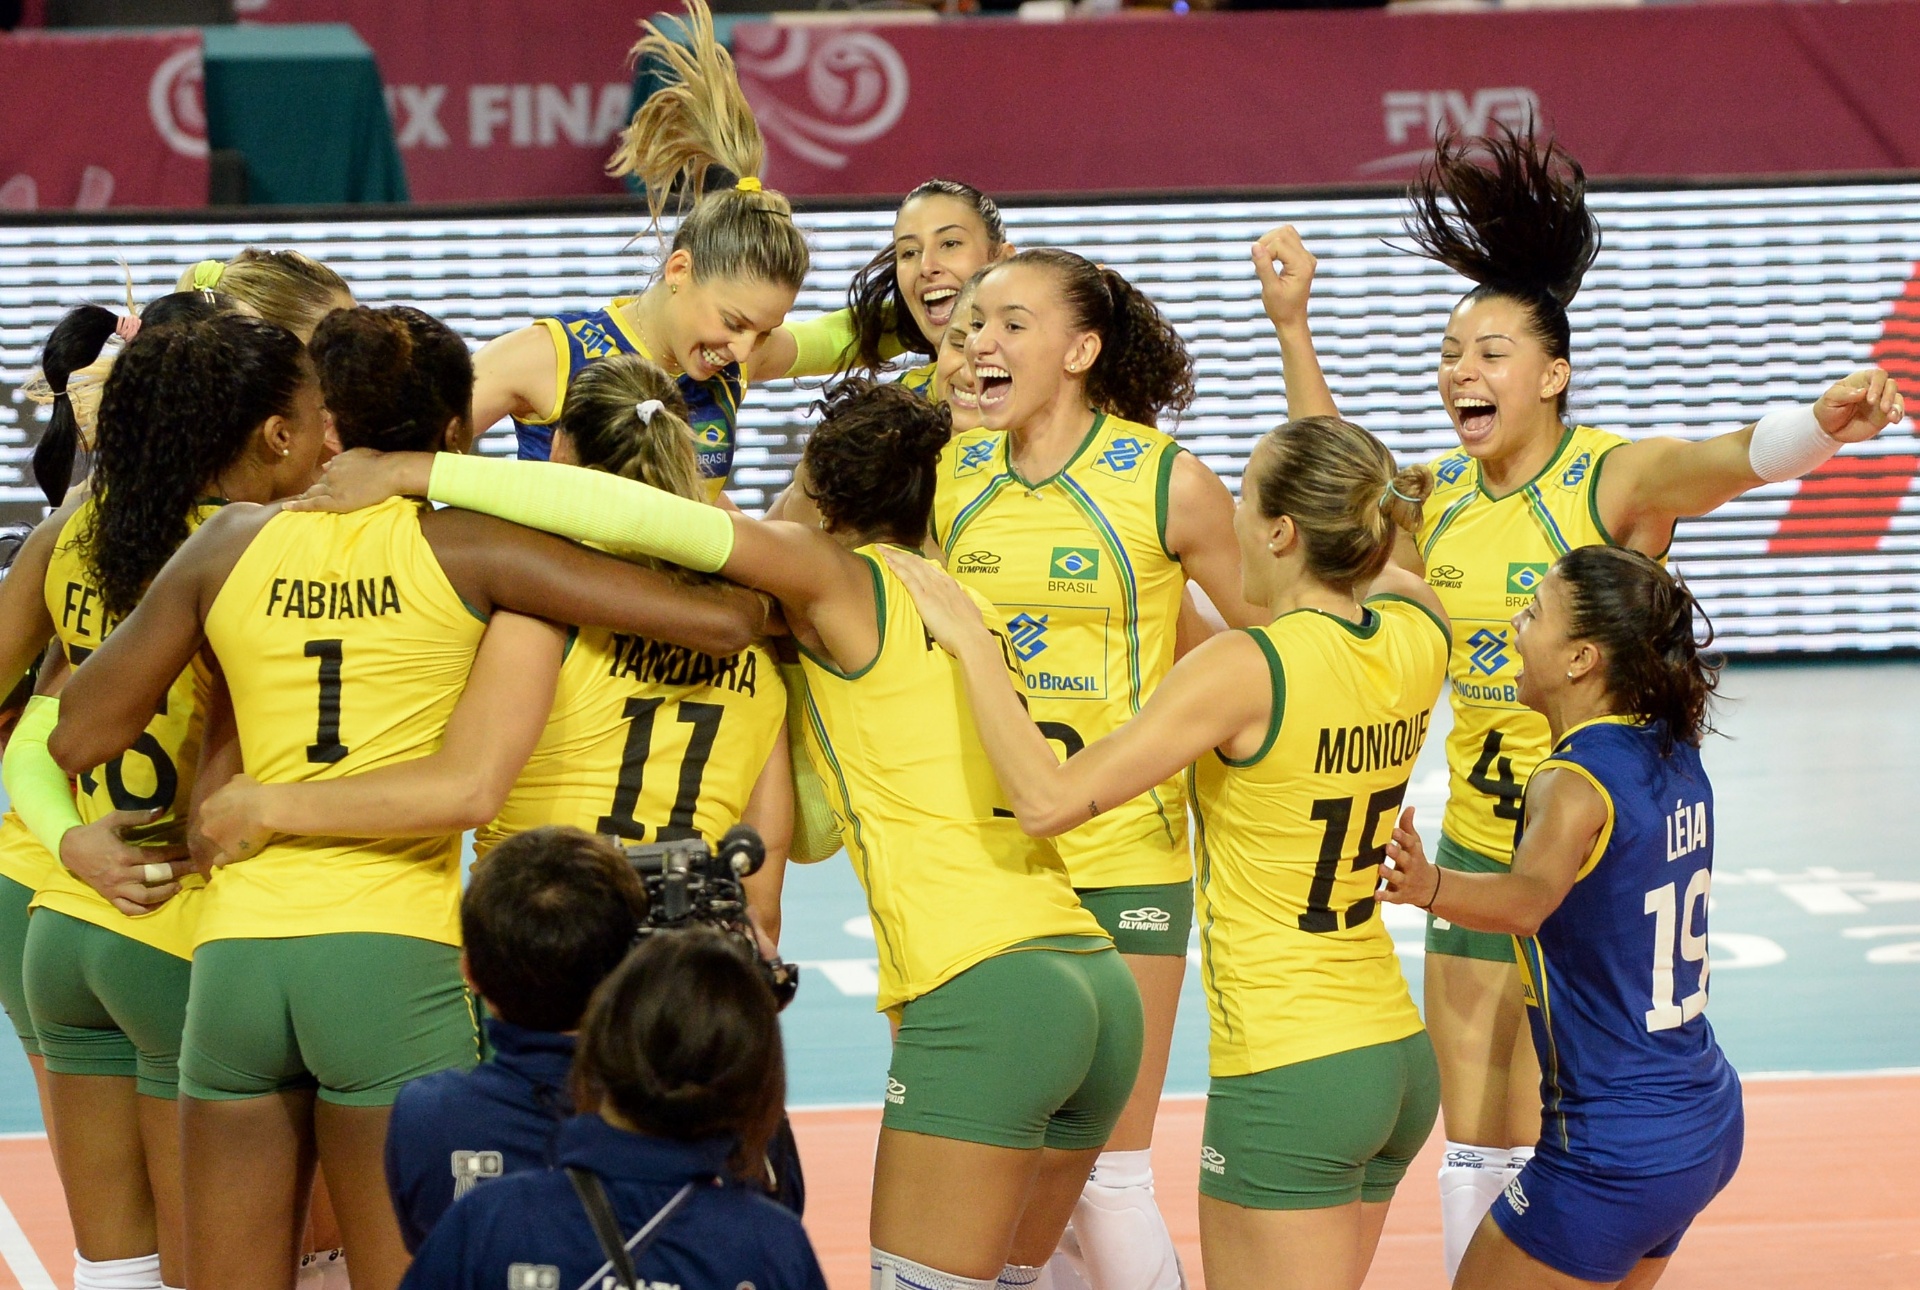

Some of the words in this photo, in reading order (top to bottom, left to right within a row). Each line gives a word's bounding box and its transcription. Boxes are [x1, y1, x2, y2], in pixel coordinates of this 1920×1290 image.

[385, 84, 449, 147] X
[266, 576, 401, 620] FABIANA
[956, 565, 1001, 574] OLYMPIKUS
[1048, 580, 1098, 594] BRASIL
[304, 639, 348, 764] 1
[1039, 672, 1099, 692] BRASIL
[1482, 686, 1502, 701] DO
[596, 697, 724, 842] 11
[1314, 708, 1430, 774] MONIQUE
[1467, 729, 1524, 820] 4
[1298, 777, 1409, 933] 15
[1666, 798, 1707, 862] LÉIA
[1118, 920, 1170, 931] OLYMPIKUS
[1644, 867, 1711, 1033] 19
